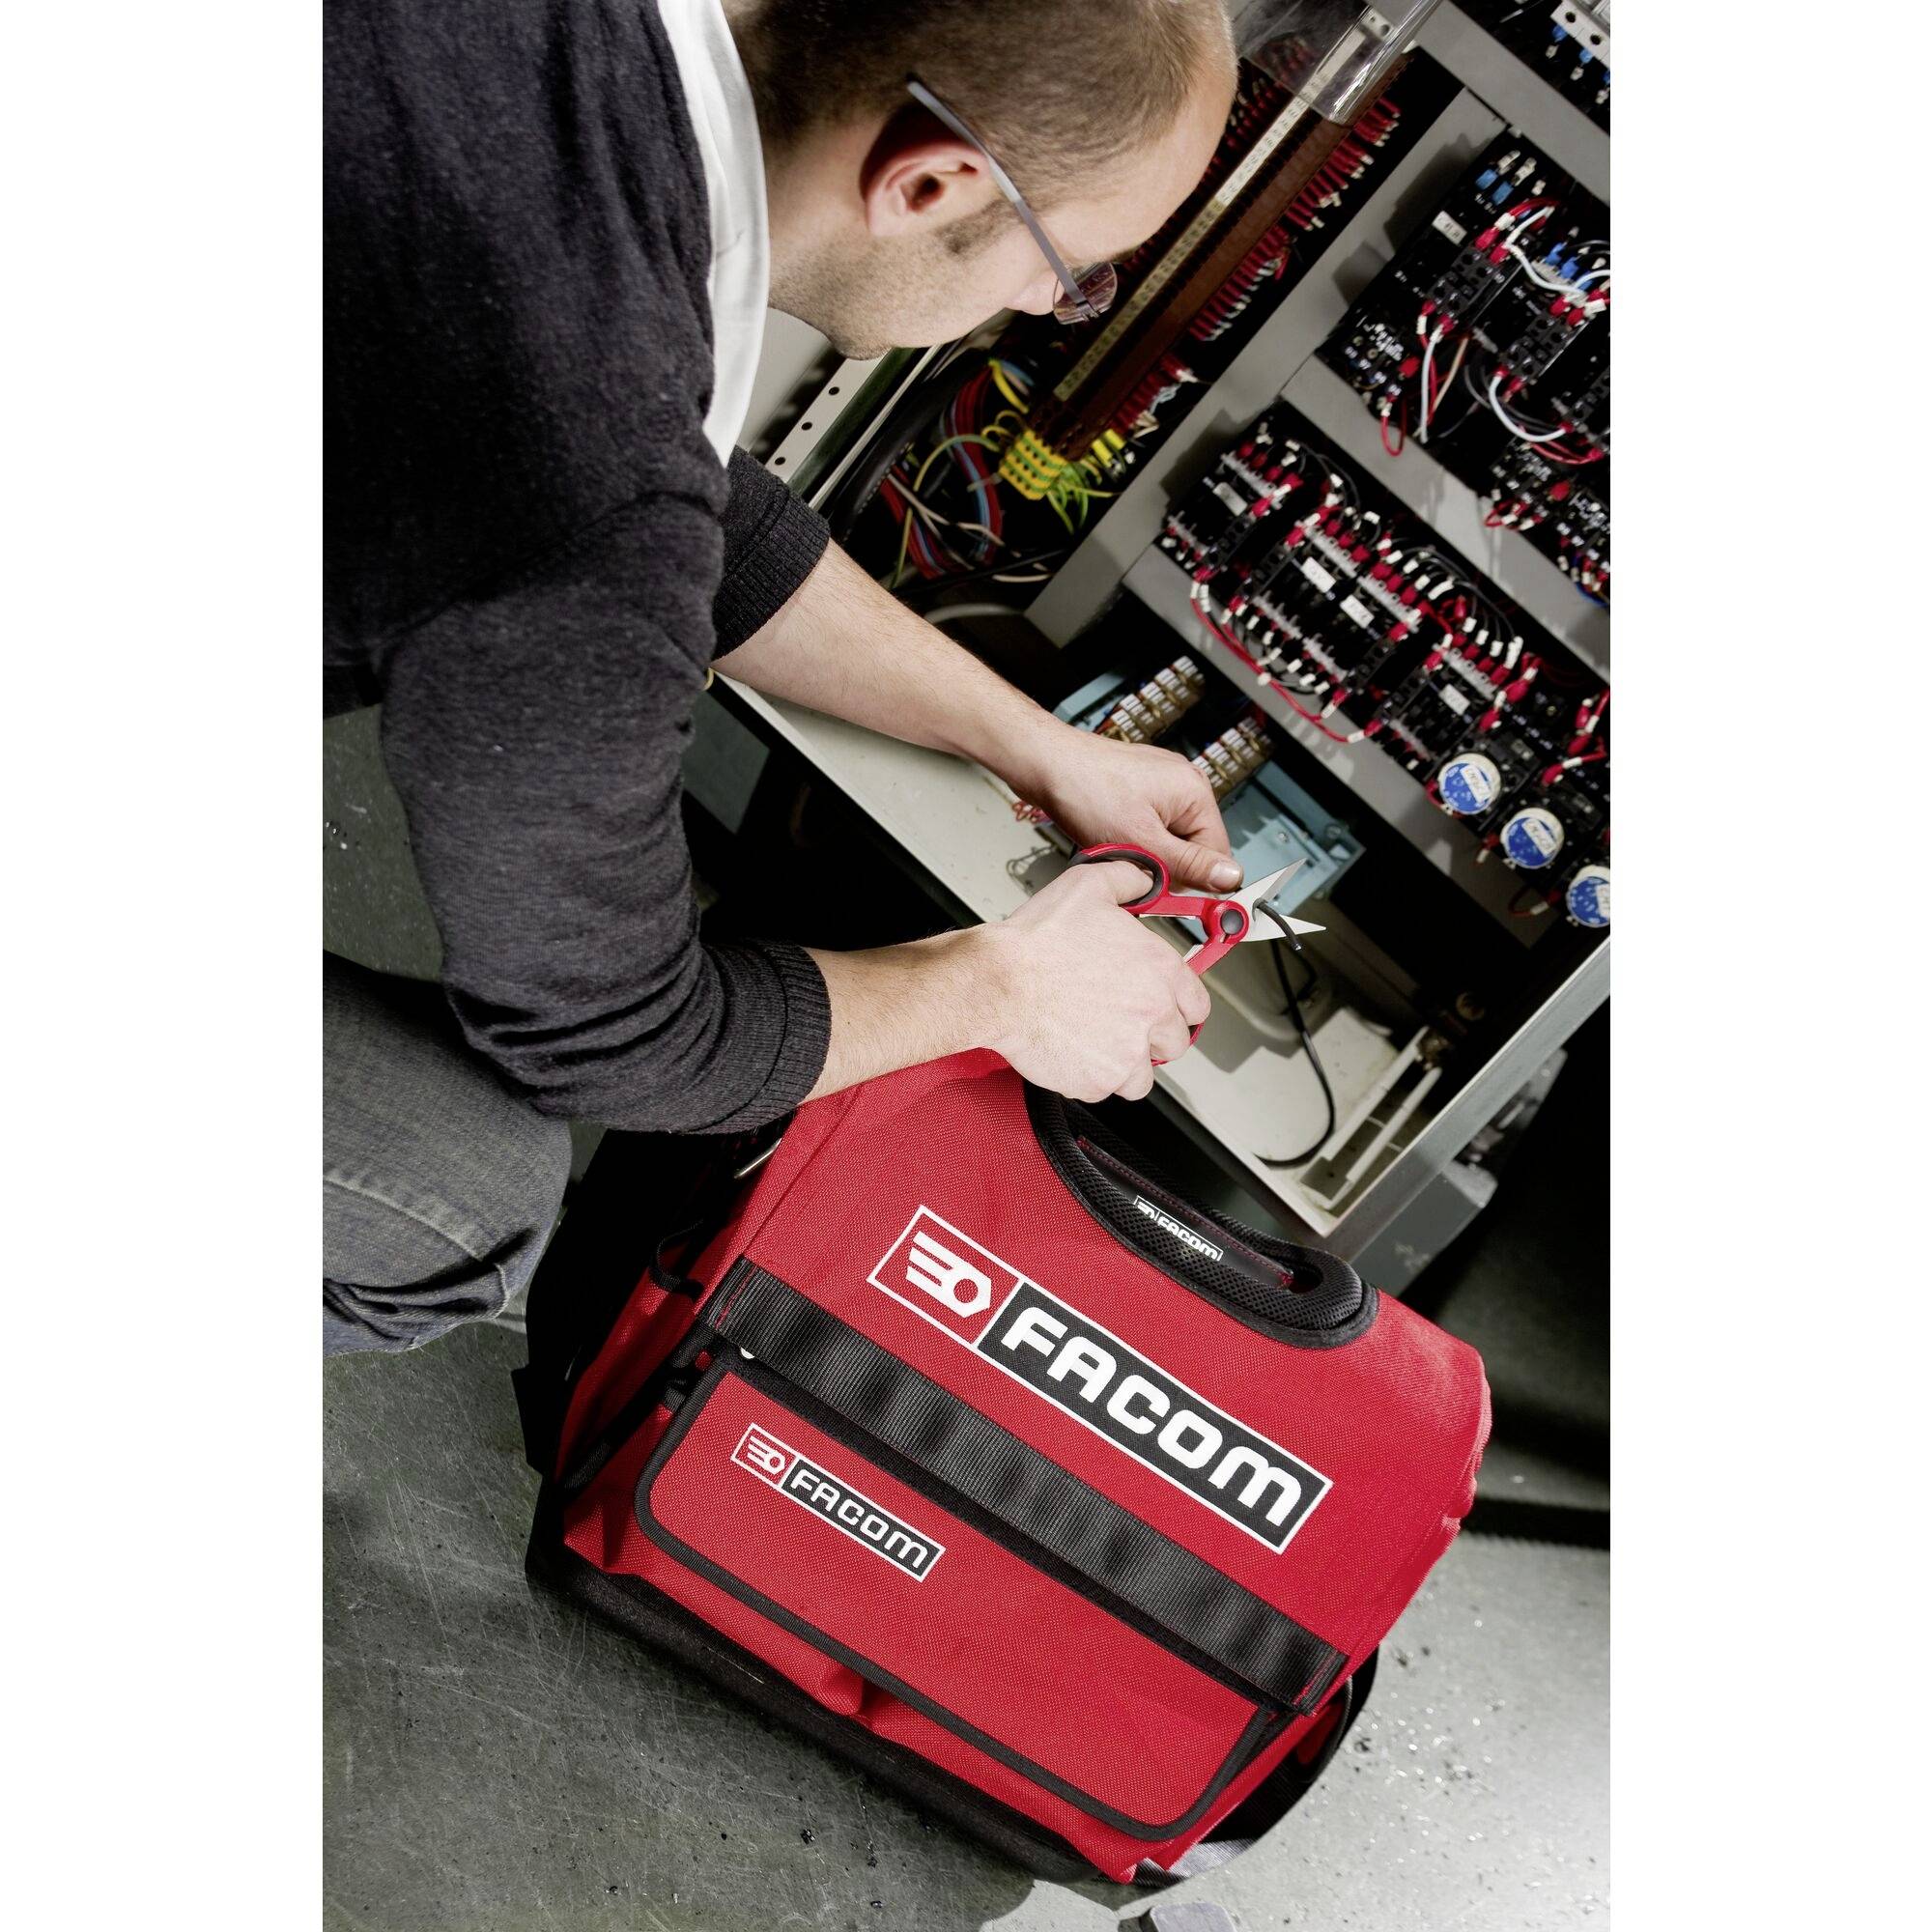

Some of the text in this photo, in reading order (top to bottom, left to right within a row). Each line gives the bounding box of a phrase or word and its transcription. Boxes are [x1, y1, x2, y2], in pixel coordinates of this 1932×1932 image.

[1157, 1215, 1218, 1261] FACOM
[1001, 1306, 1301, 1526] FACOM
[790, 1468, 927, 1569] FACOM
